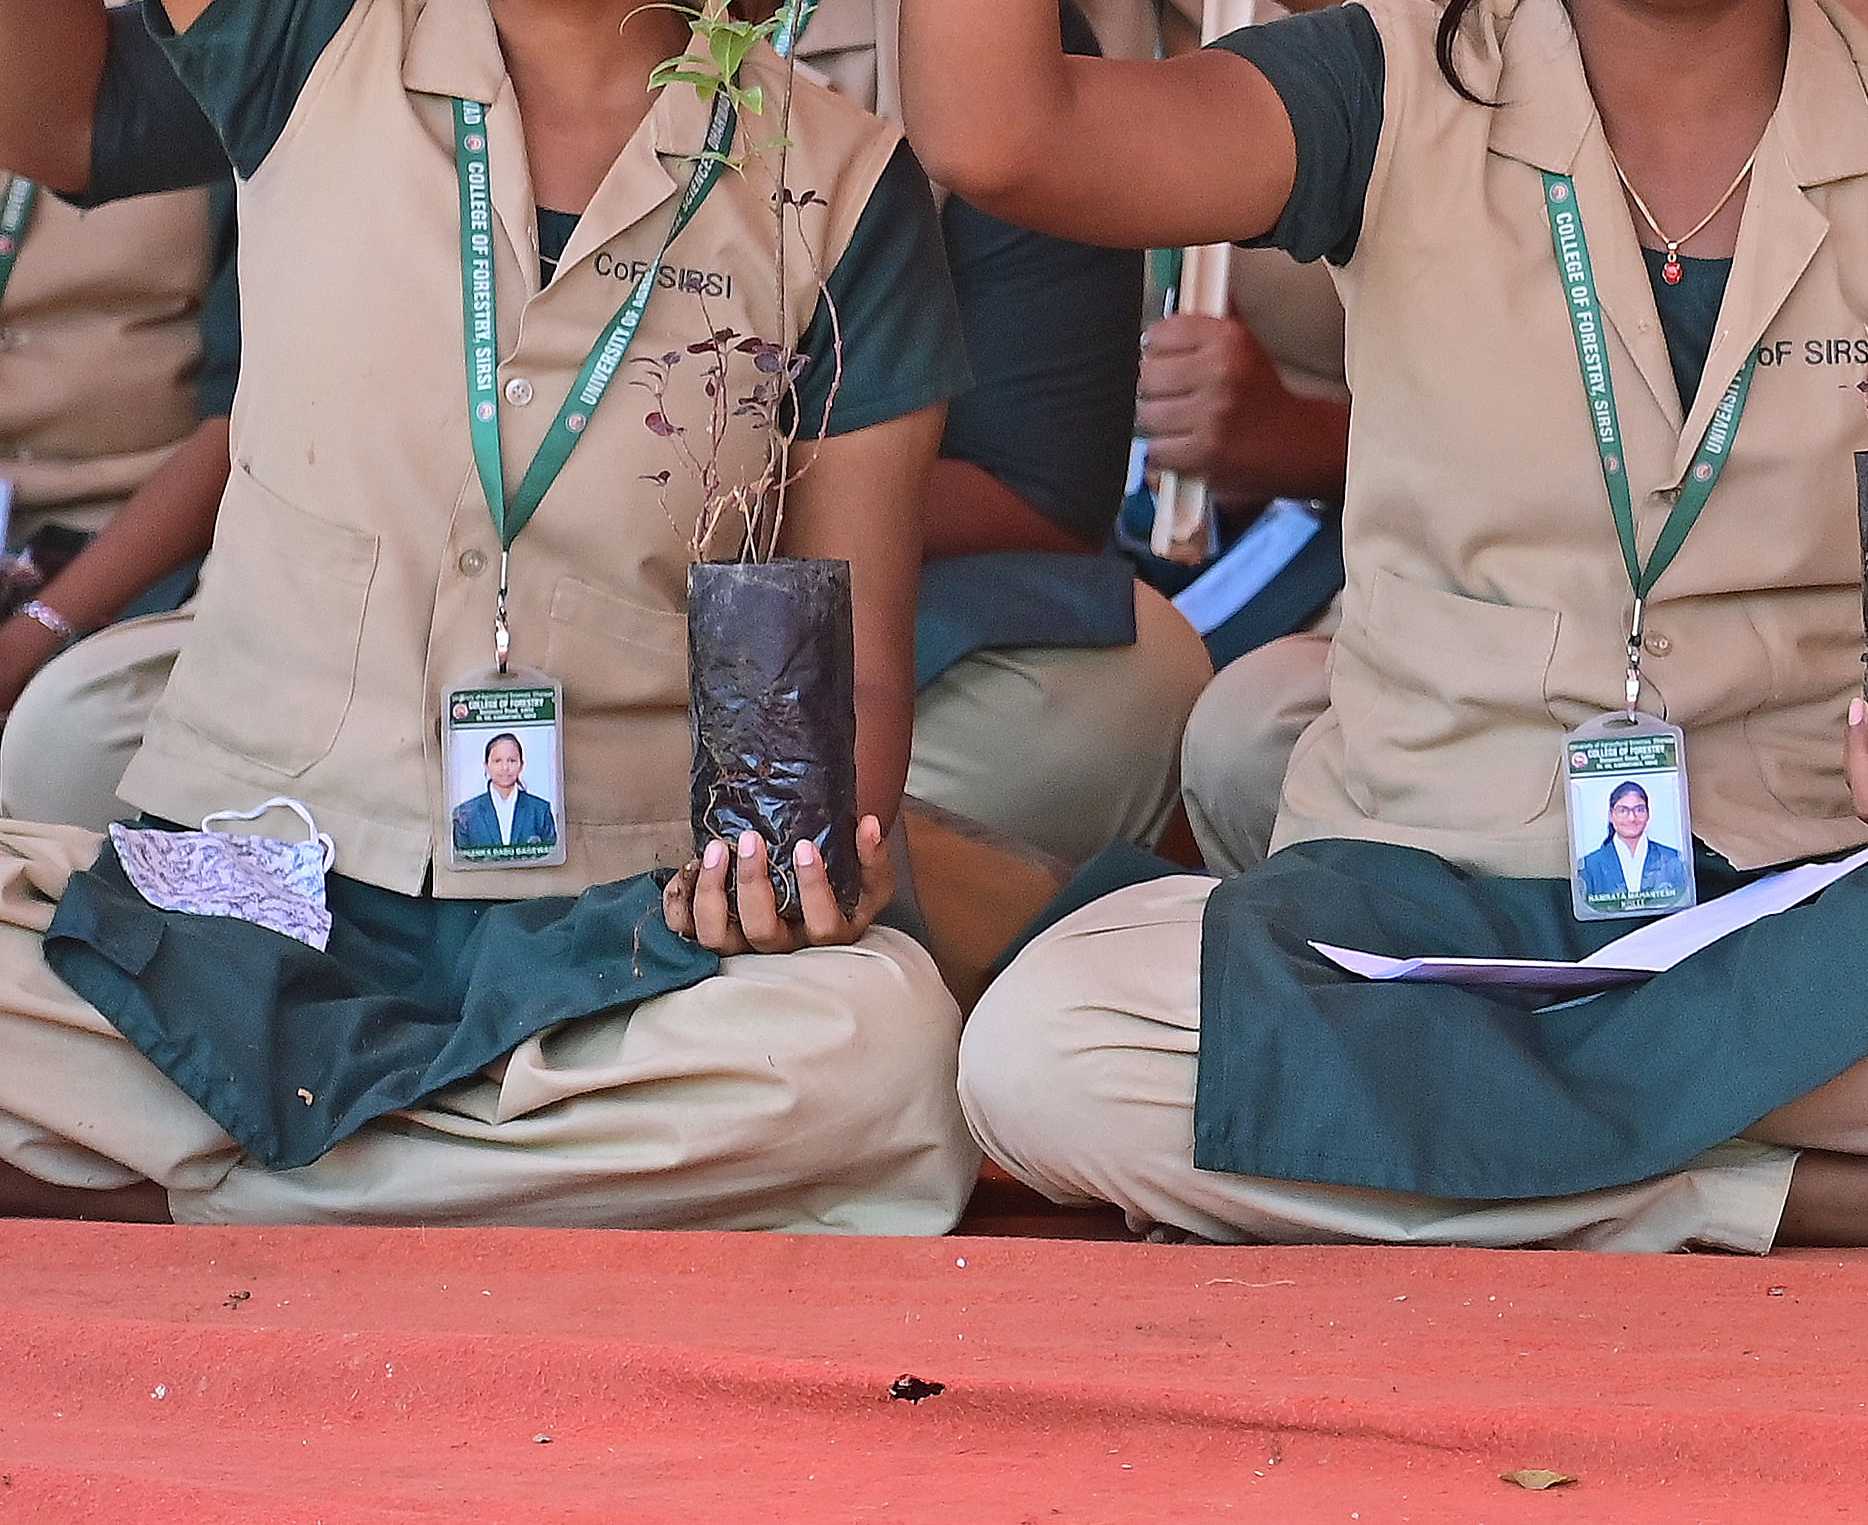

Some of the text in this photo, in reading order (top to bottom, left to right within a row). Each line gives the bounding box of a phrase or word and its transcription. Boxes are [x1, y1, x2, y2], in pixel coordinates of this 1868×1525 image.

[467, 161, 488, 230] COLLEGE
[471, 234, 490, 256] OF
[593, 251, 647, 283] CoF
[657, 264, 734, 301] SIRSI
[471, 261, 493, 342] FORESTRY,
[1555, 212, 1617, 445] COLLEGE OF FORESTRY, SIRSI
[474, 346, 494, 392] SIRSI
[579, 324, 631, 406] UNIVERSITY
